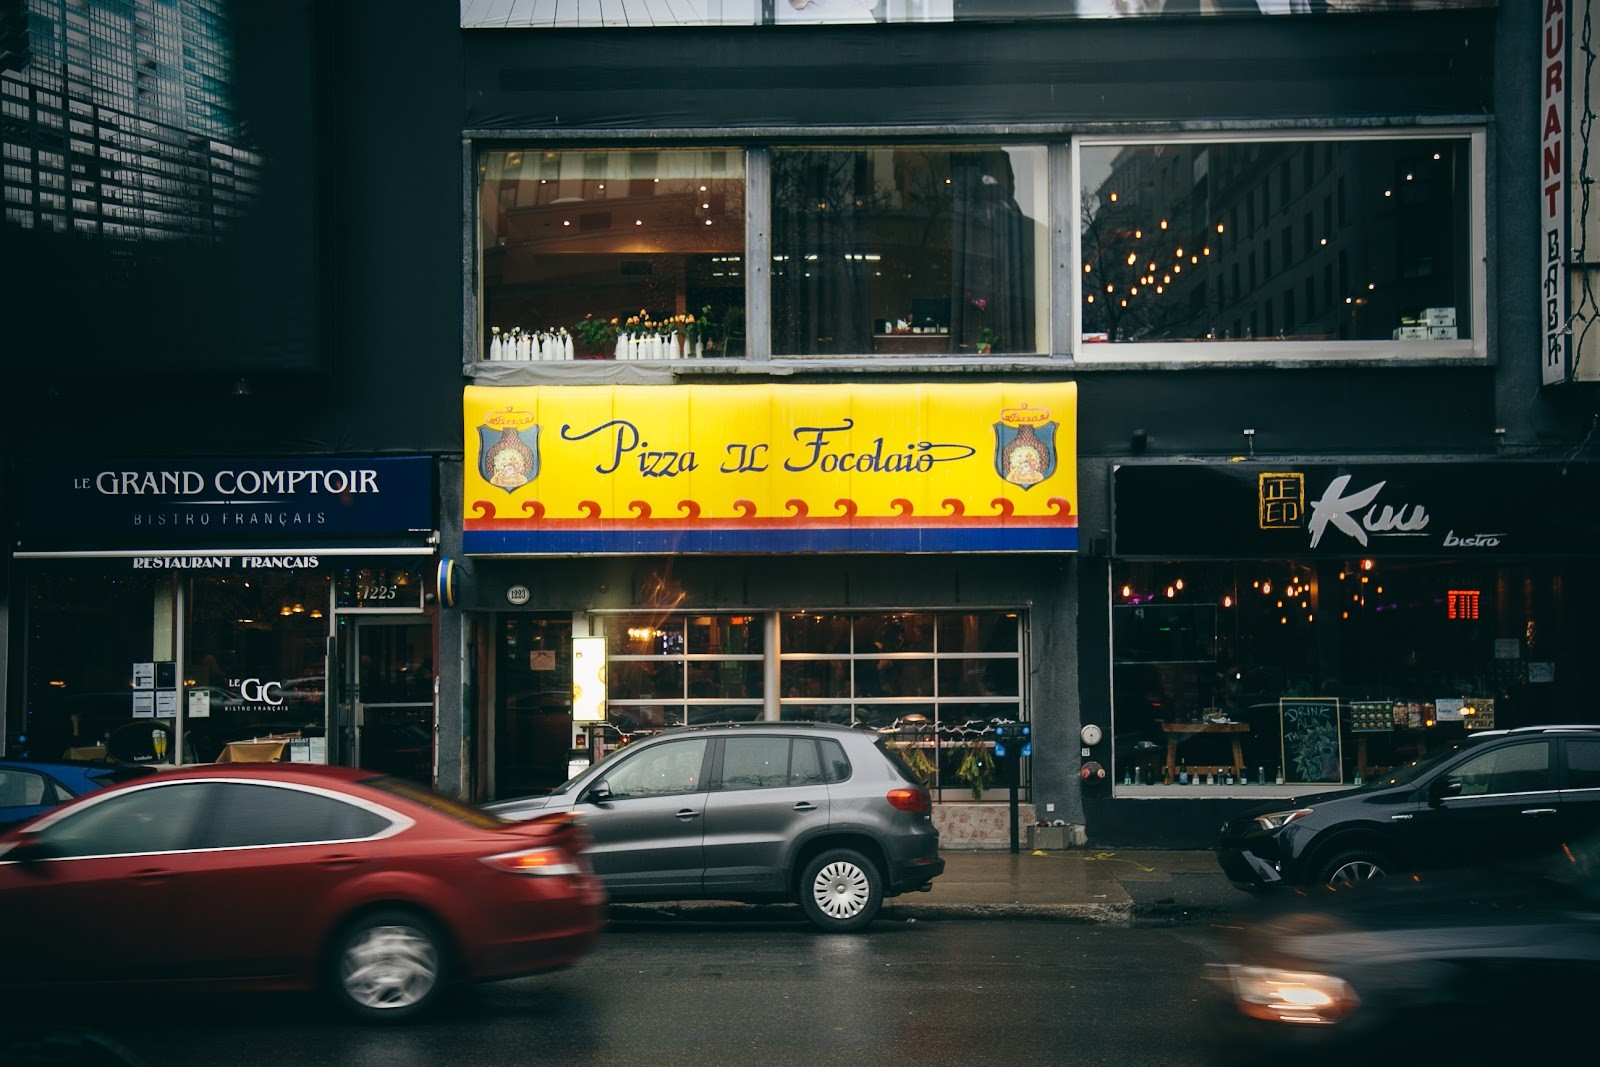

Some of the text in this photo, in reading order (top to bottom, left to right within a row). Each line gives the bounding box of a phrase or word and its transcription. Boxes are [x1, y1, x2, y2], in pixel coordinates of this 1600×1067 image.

[561, 421, 699, 477] Pizza
[784, 419, 976, 472] Focolaio
[74, 469, 380, 495] LE GRAND COMPTOIR
[134, 512, 326, 527] BISTRO FRANÇAIS
[1308, 474, 1430, 549] Kuu
[1443, 530, 1508, 547] bistro
[132, 556, 319, 569] RESTAURANT FRANCAIS
[362, 585, 398, 601] 1225
[510, 589, 526, 600] 1223
[228, 678, 284, 706] LE GC
[1284, 706, 1331, 722] DRINK
